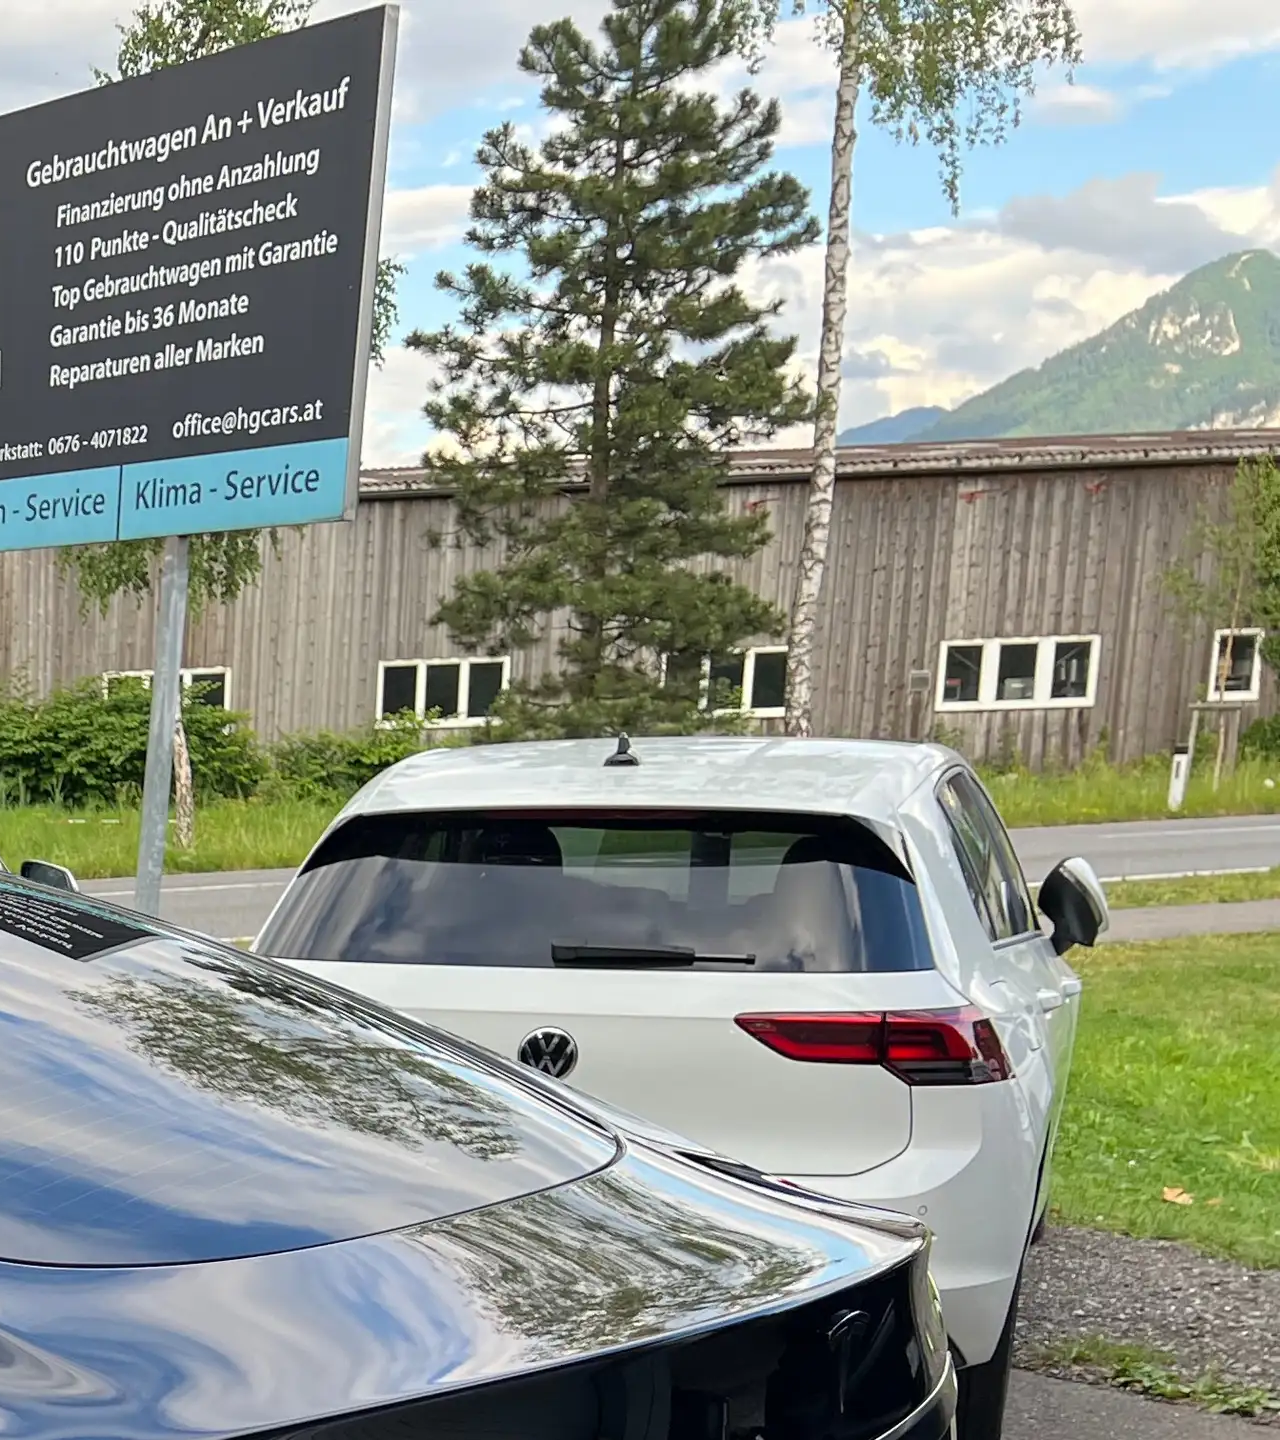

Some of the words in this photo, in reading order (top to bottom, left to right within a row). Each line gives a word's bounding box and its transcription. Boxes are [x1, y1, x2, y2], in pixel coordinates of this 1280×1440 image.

[26, 126, 197, 188] Gebrauchtwagen
[201, 114, 231, 145] An
[237, 110, 254, 134] +
[257, 76, 351, 130] Verkauf
[56, 185, 164, 228] Finanzierung
[168, 173, 214, 202] ohne
[217, 149, 320, 191] Anzahlung
[54, 241, 85, 268] 110
[89, 229, 150, 261] Punkte
[162, 192, 299, 246] Qualitätscheck
[52, 285, 81, 311] Top
[83, 257, 222, 302] Gebrauchtwagen
[224, 247, 256, 274] mit
[257, 230, 339, 268] Garantie
[49, 315, 122, 348] Garantie
[123, 311, 150, 335] bis
[152, 304, 176, 330] 36
[178, 293, 250, 324] Monate
[49, 350, 151, 389] Reparaturen
[153, 344, 193, 371] aller
[194, 332, 265, 364] Marken
[48, 434, 80, 456] 0676
[90, 425, 148, 450] 4071822
[172, 399, 324, 440] office@hgcars.at
[25, 488, 105, 523] Service
[135, 478, 201, 510] Klima
[224, 464, 320, 501] Service
